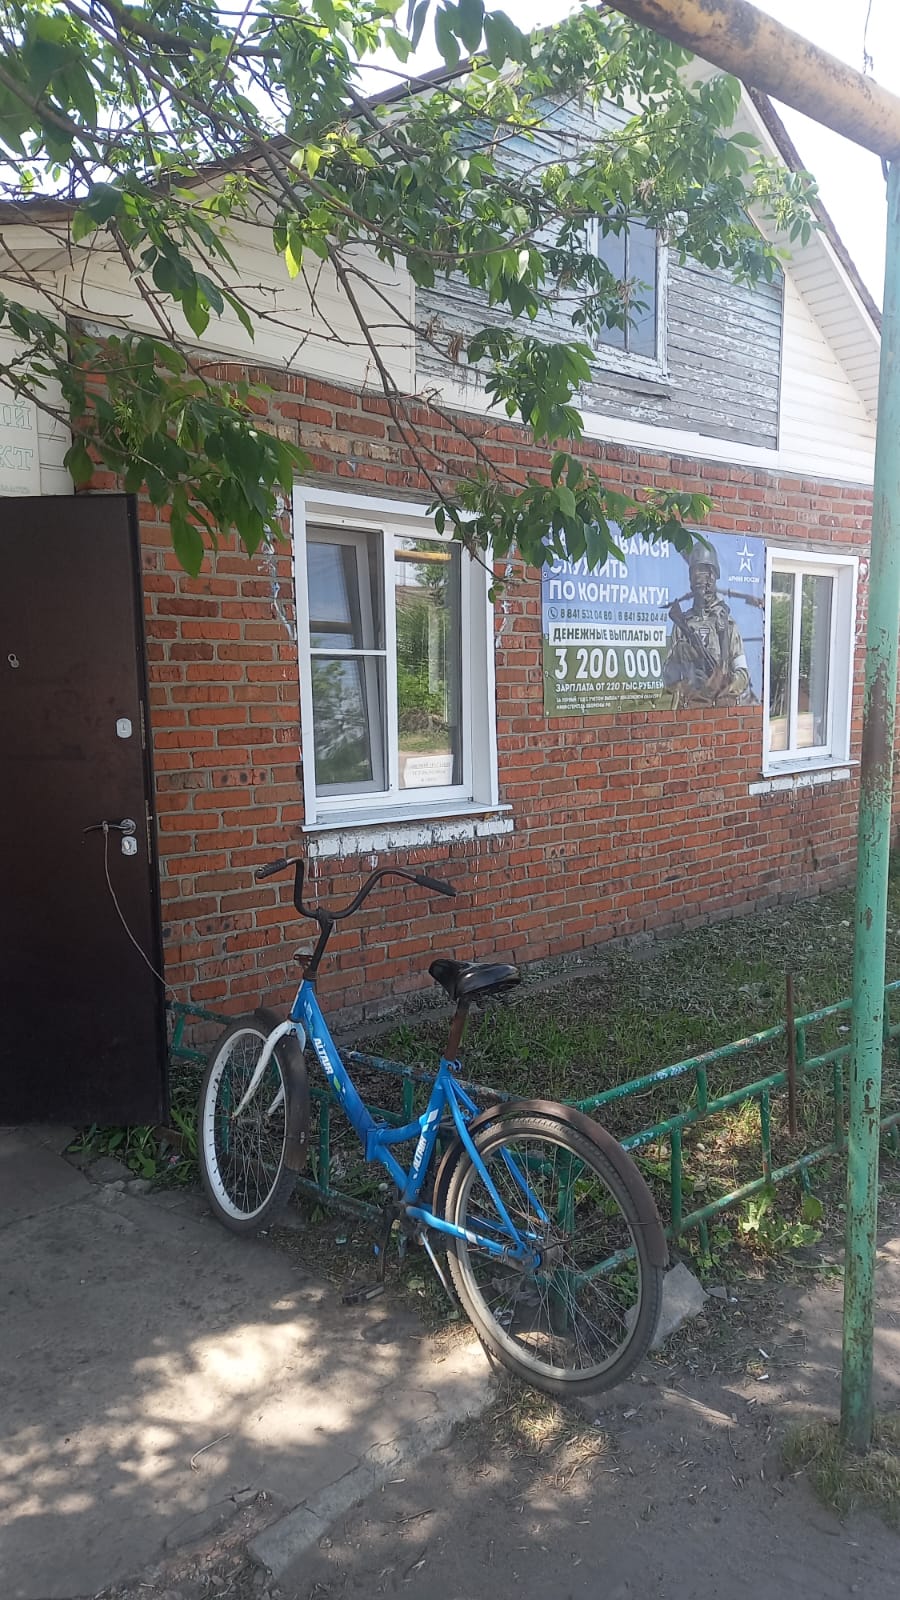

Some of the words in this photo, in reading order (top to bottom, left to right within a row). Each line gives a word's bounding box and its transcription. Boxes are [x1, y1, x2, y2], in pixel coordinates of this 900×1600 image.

[549, 579, 575, 600] ПО
[577, 582, 669, 605] КОНТРАКТУ!
[560, 608, 565, 619] 8
[567, 608, 580, 619] 841
[636, 612, 649, 622] 532
[650, 612, 659, 622] 04
[553, 627, 608, 642] ДЕНЕЖНЫЕ
[609, 629, 652, 641] ВЫПЛАТЫ
[653, 630, 664, 642] ОТ
[554, 648, 568, 679] 3
[576, 648, 618, 679] 200
[624, 649, 661, 678] 000
[555, 682, 594, 692] ЗАРПЛАТА
[595, 682, 605, 691] ОТ
[606, 682, 620, 691] 220
[313, 1037, 334, 1075] ALTAIR
